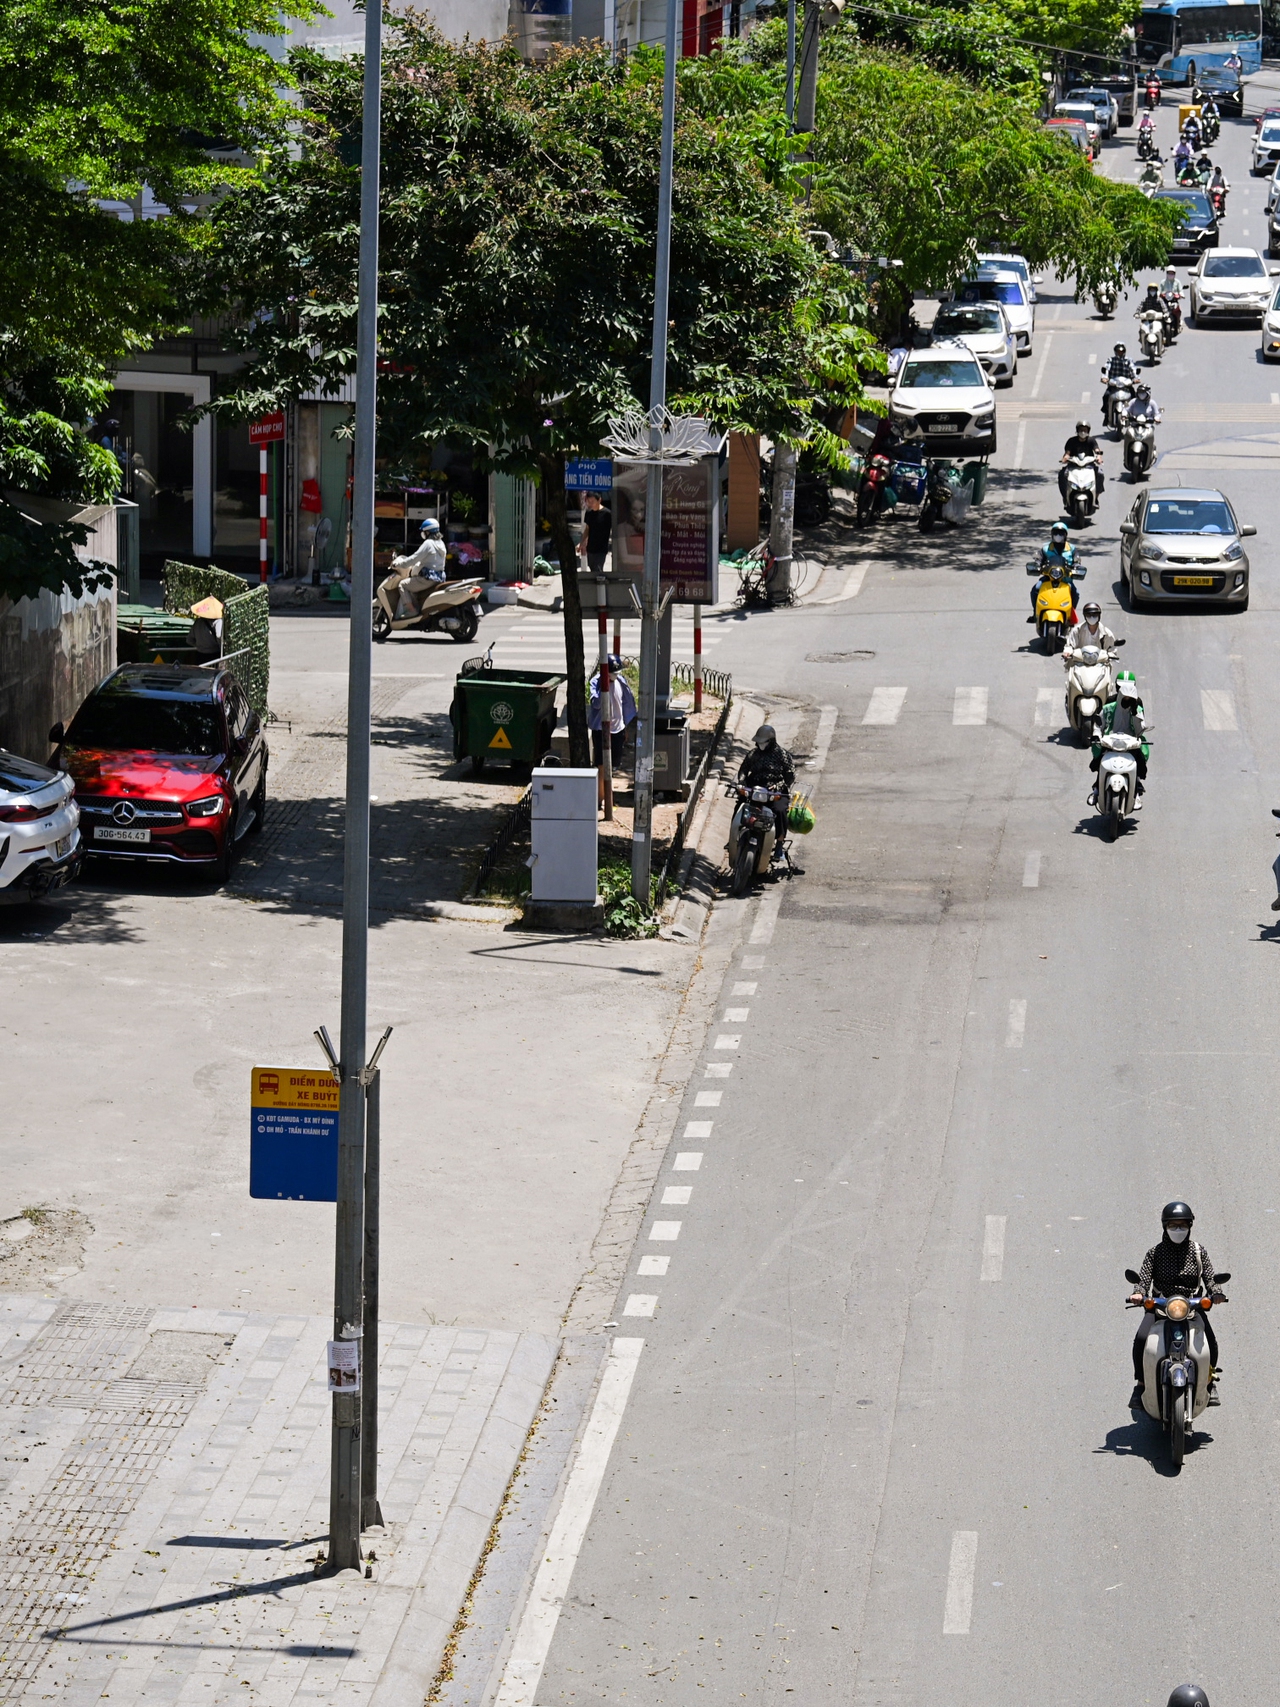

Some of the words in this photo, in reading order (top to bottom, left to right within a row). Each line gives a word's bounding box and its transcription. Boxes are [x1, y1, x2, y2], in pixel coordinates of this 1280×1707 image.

[578, 462, 597, 470] PHỐ
[564, 471, 577, 486] ẶNG
[579, 471, 593, 485] TIẾN
[666, 498, 678, 509] 51
[678, 587, 690, 597] 69
[692, 587, 704, 597] 68
[290, 1074, 315, 1087] ĐIỂM
[297, 1091, 309, 1099] XE
[313, 1090, 337, 1101] BUÝT
